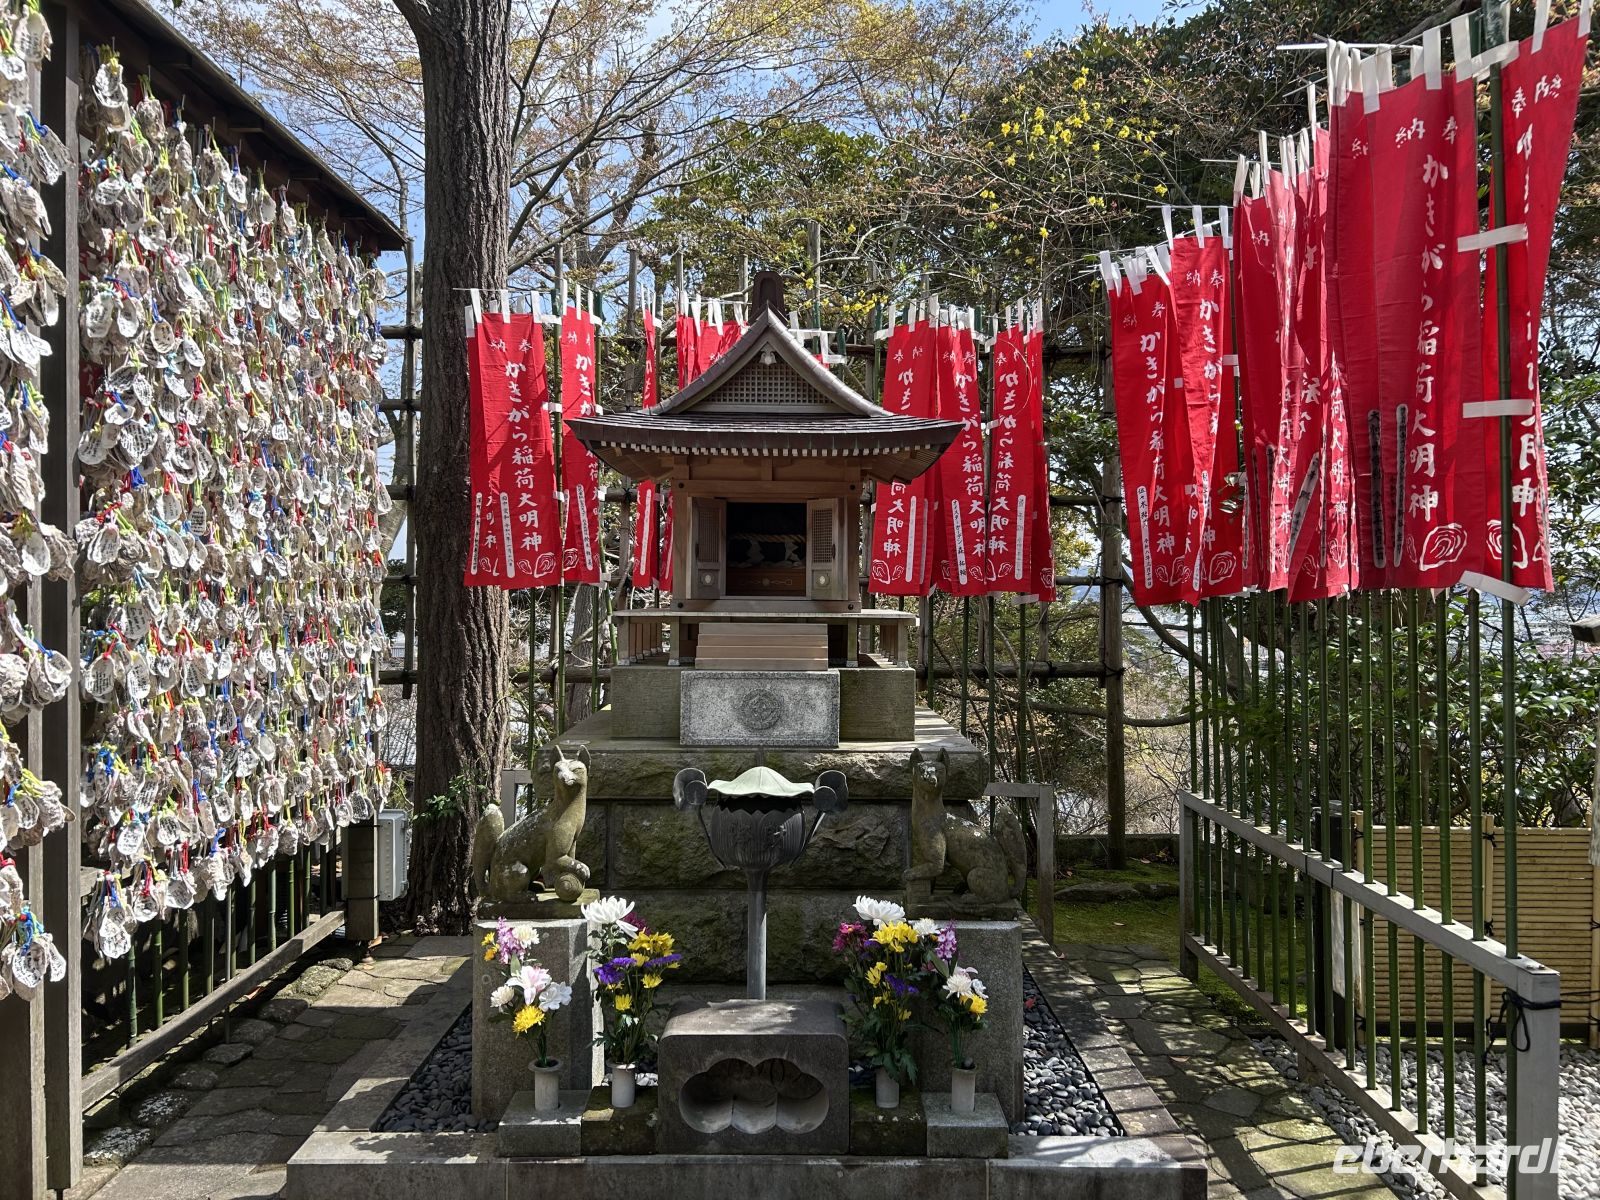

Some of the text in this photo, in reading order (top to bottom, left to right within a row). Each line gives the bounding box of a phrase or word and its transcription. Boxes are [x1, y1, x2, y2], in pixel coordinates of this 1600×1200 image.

[505, 361, 542, 552] かきがら稲荷大明神
[1408, 154, 1449, 522] かきがら稲荷大明神
